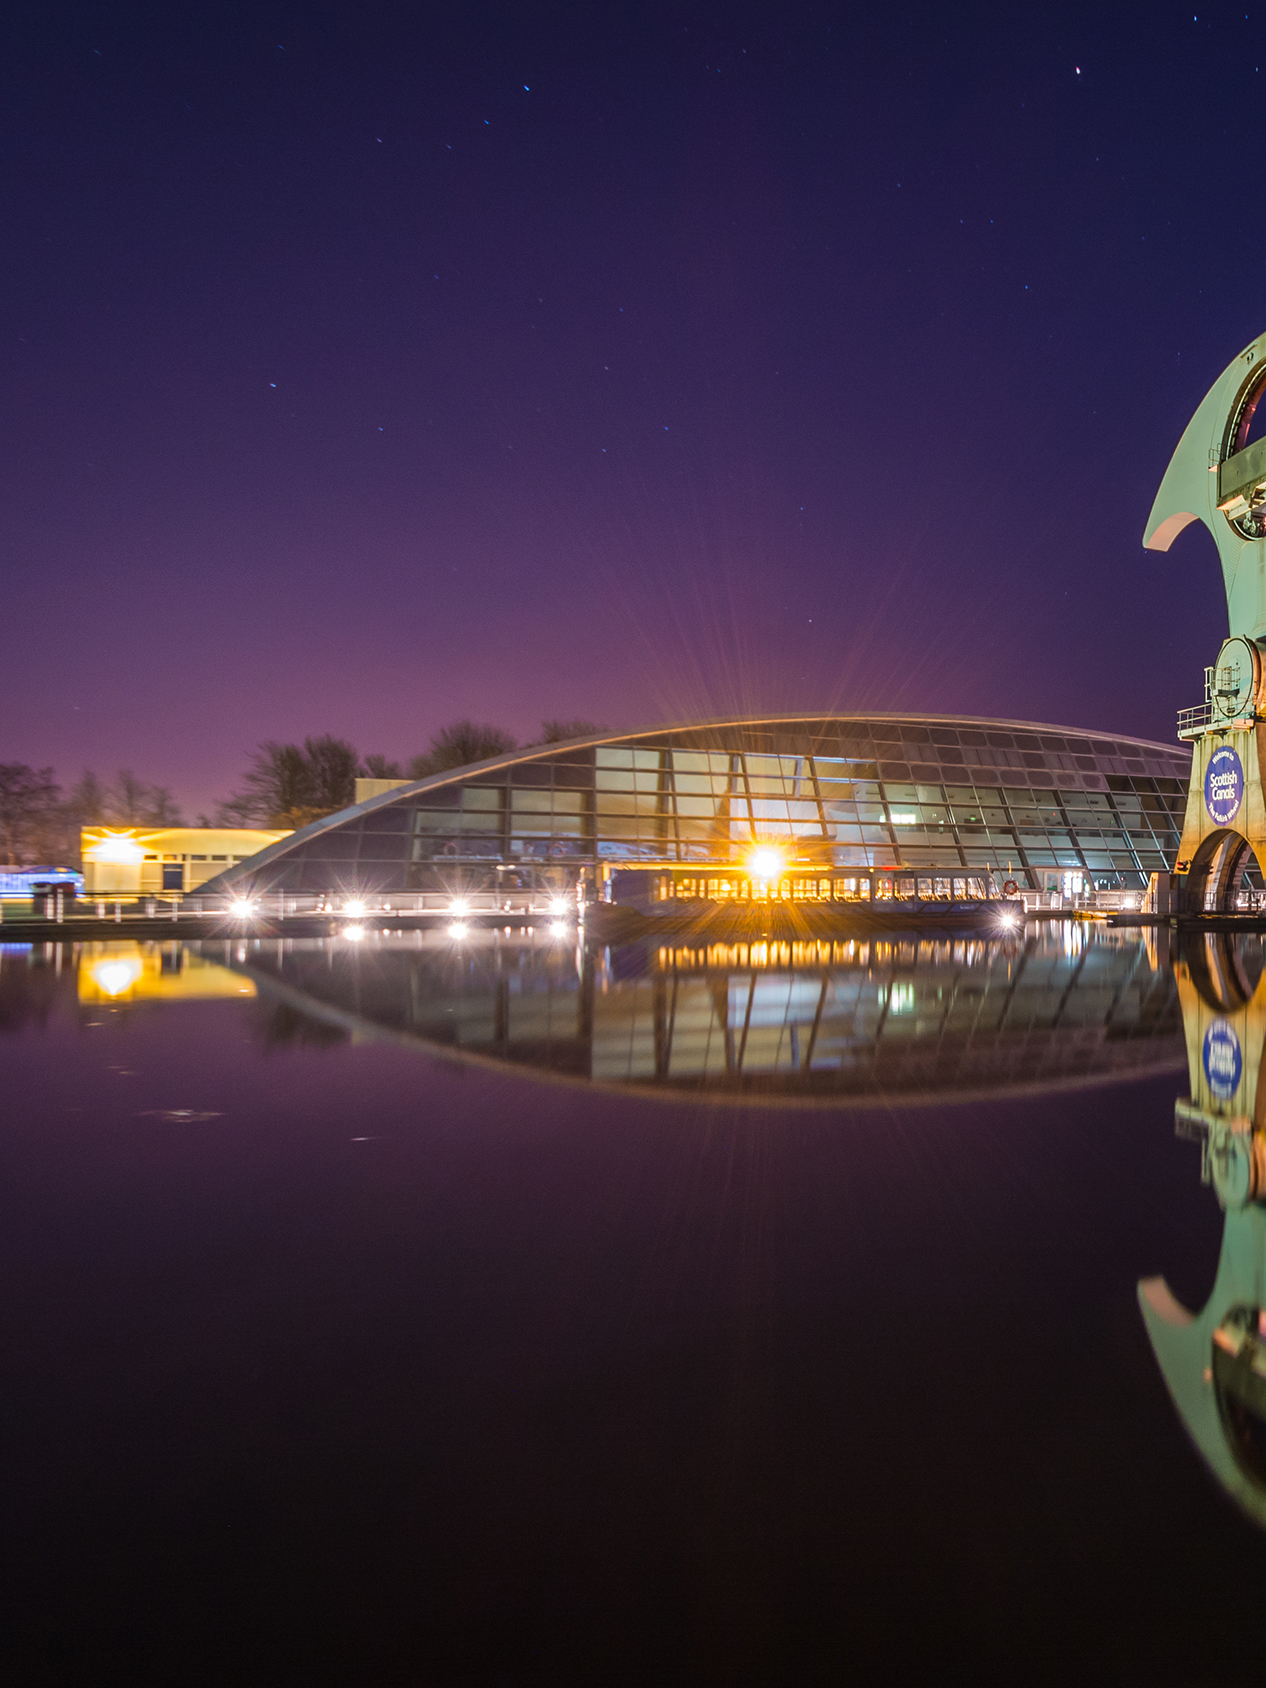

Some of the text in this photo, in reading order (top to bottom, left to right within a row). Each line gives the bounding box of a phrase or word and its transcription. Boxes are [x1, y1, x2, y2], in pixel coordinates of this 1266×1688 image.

[1212, 751, 1229, 764] Welcome
[1210, 770, 1237, 787] Scottish
[1212, 784, 1235, 800] Canals
[1214, 812, 1228, 822] Falkirk
[1227, 799, 1239, 819] Wheel
